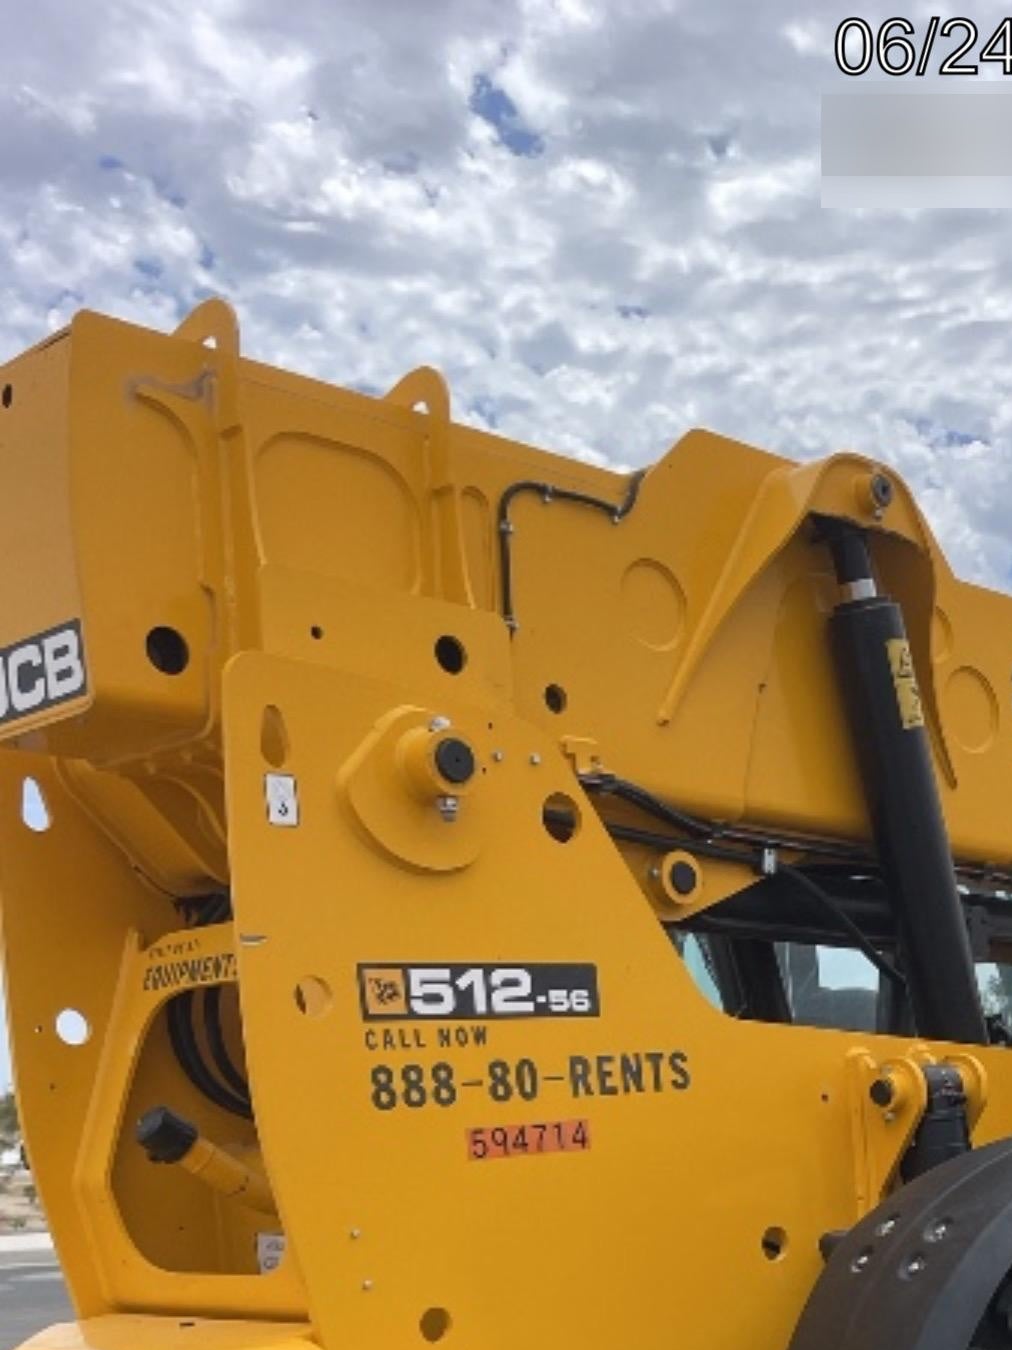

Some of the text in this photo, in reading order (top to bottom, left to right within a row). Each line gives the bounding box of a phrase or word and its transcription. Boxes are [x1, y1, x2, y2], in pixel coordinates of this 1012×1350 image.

[0, 629, 84, 717] CB
[408, 968, 591, 1015] 512-56
[365, 1026, 489, 1050] CALL NOW
[370, 1051, 692, 1111] 888-80-RENTS
[470, 1121, 589, 1159] 594714
